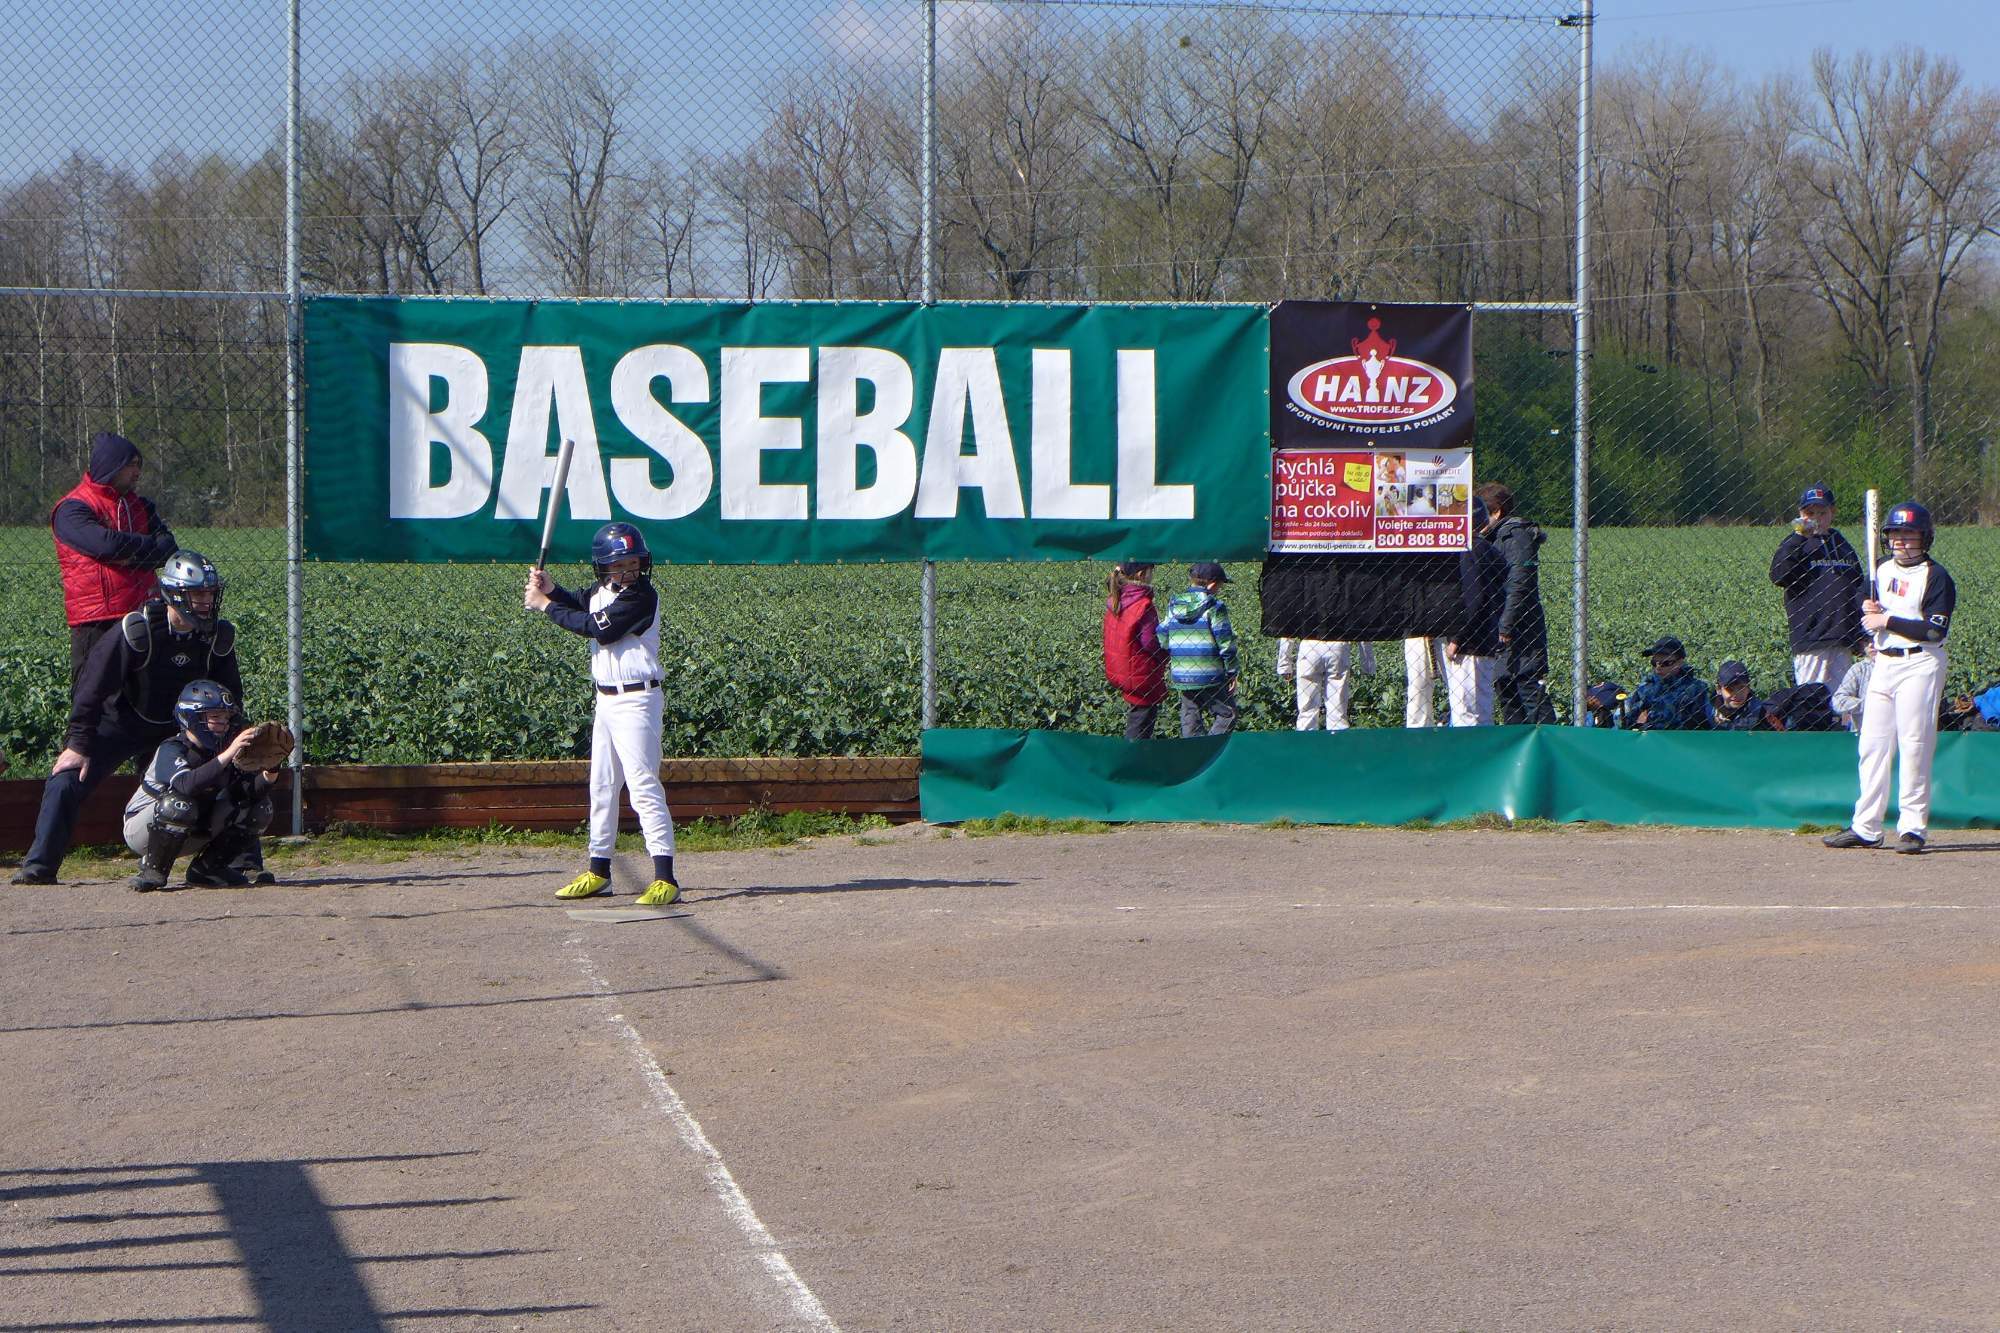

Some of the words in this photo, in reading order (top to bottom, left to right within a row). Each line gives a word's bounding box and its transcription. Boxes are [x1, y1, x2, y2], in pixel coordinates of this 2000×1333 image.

[1286, 402, 1345, 432] SPORTOVNÍ
[1349, 425, 1401, 434] TROFEJE
[1403, 424, 1412, 432] A
[1414, 406, 1457, 429] POHÁRY
[1329, 405, 1415, 414] www.TROFEJE.cz
[389, 342, 1194, 521] BASEBALL
[1275, 457, 1335, 478] Rychlá
[1275, 478, 1337, 500] půjčka
[1275, 504, 1298, 518] na
[1304, 500, 1371, 519] cokoliv
[1377, 519, 1414, 531] Volejte
[1415, 520, 1454, 530] zdarma
[1377, 534, 1404, 546] 800
[1407, 534, 1435, 546] 808
[1438, 533, 1466, 546] 809
